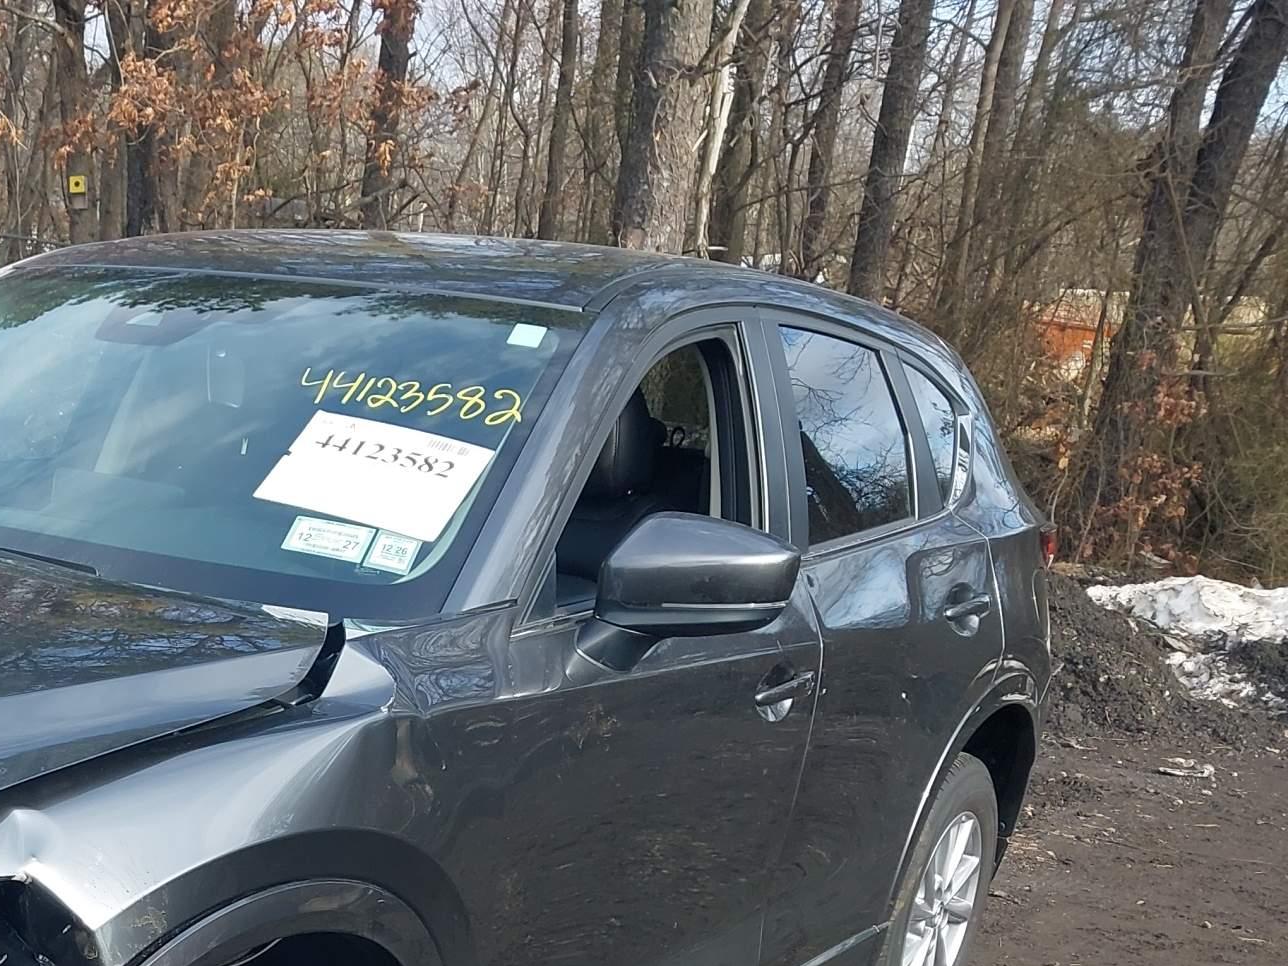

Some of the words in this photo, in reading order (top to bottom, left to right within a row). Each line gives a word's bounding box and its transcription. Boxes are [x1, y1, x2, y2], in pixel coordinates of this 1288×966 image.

[300, 367, 523, 426] 44123582
[315, 433, 456, 479] 44123582
[297, 531, 313, 543] 12
[342, 540, 360, 551] 27
[381, 543, 392, 553] 12
